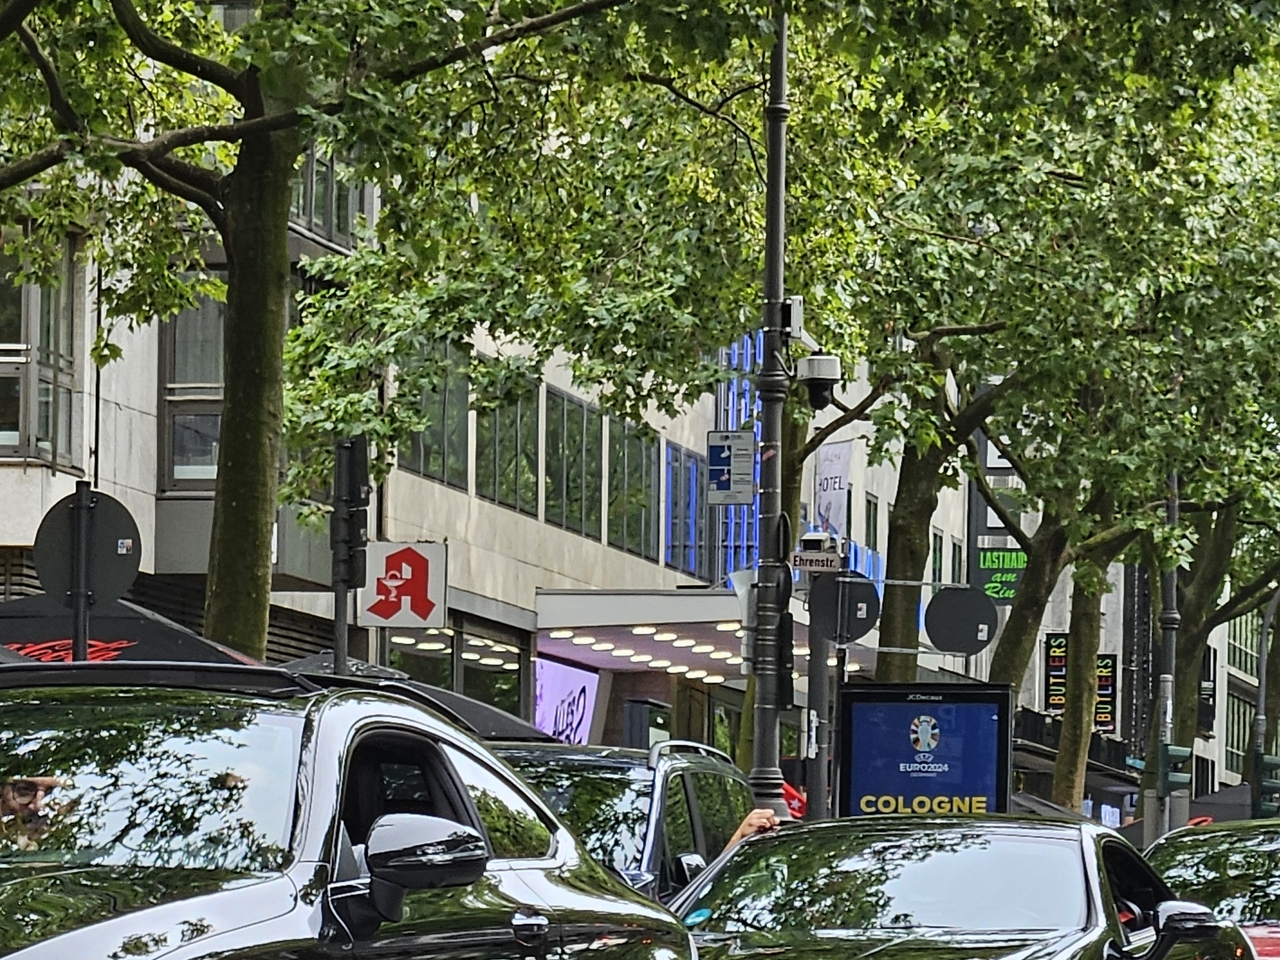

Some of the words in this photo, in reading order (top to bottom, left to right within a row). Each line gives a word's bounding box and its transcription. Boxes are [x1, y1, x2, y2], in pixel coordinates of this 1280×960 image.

[793, 555, 836, 568] Ehrenstr.
[980, 551, 1028, 569] LASTRAD
[991, 573, 1018, 582] am
[984, 582, 1017, 599] Rin
[1049, 638, 1066, 704] BUTLERS
[1096, 658, 1112, 721] BUTLERS
[859, 795, 987, 814] COLOGNE
